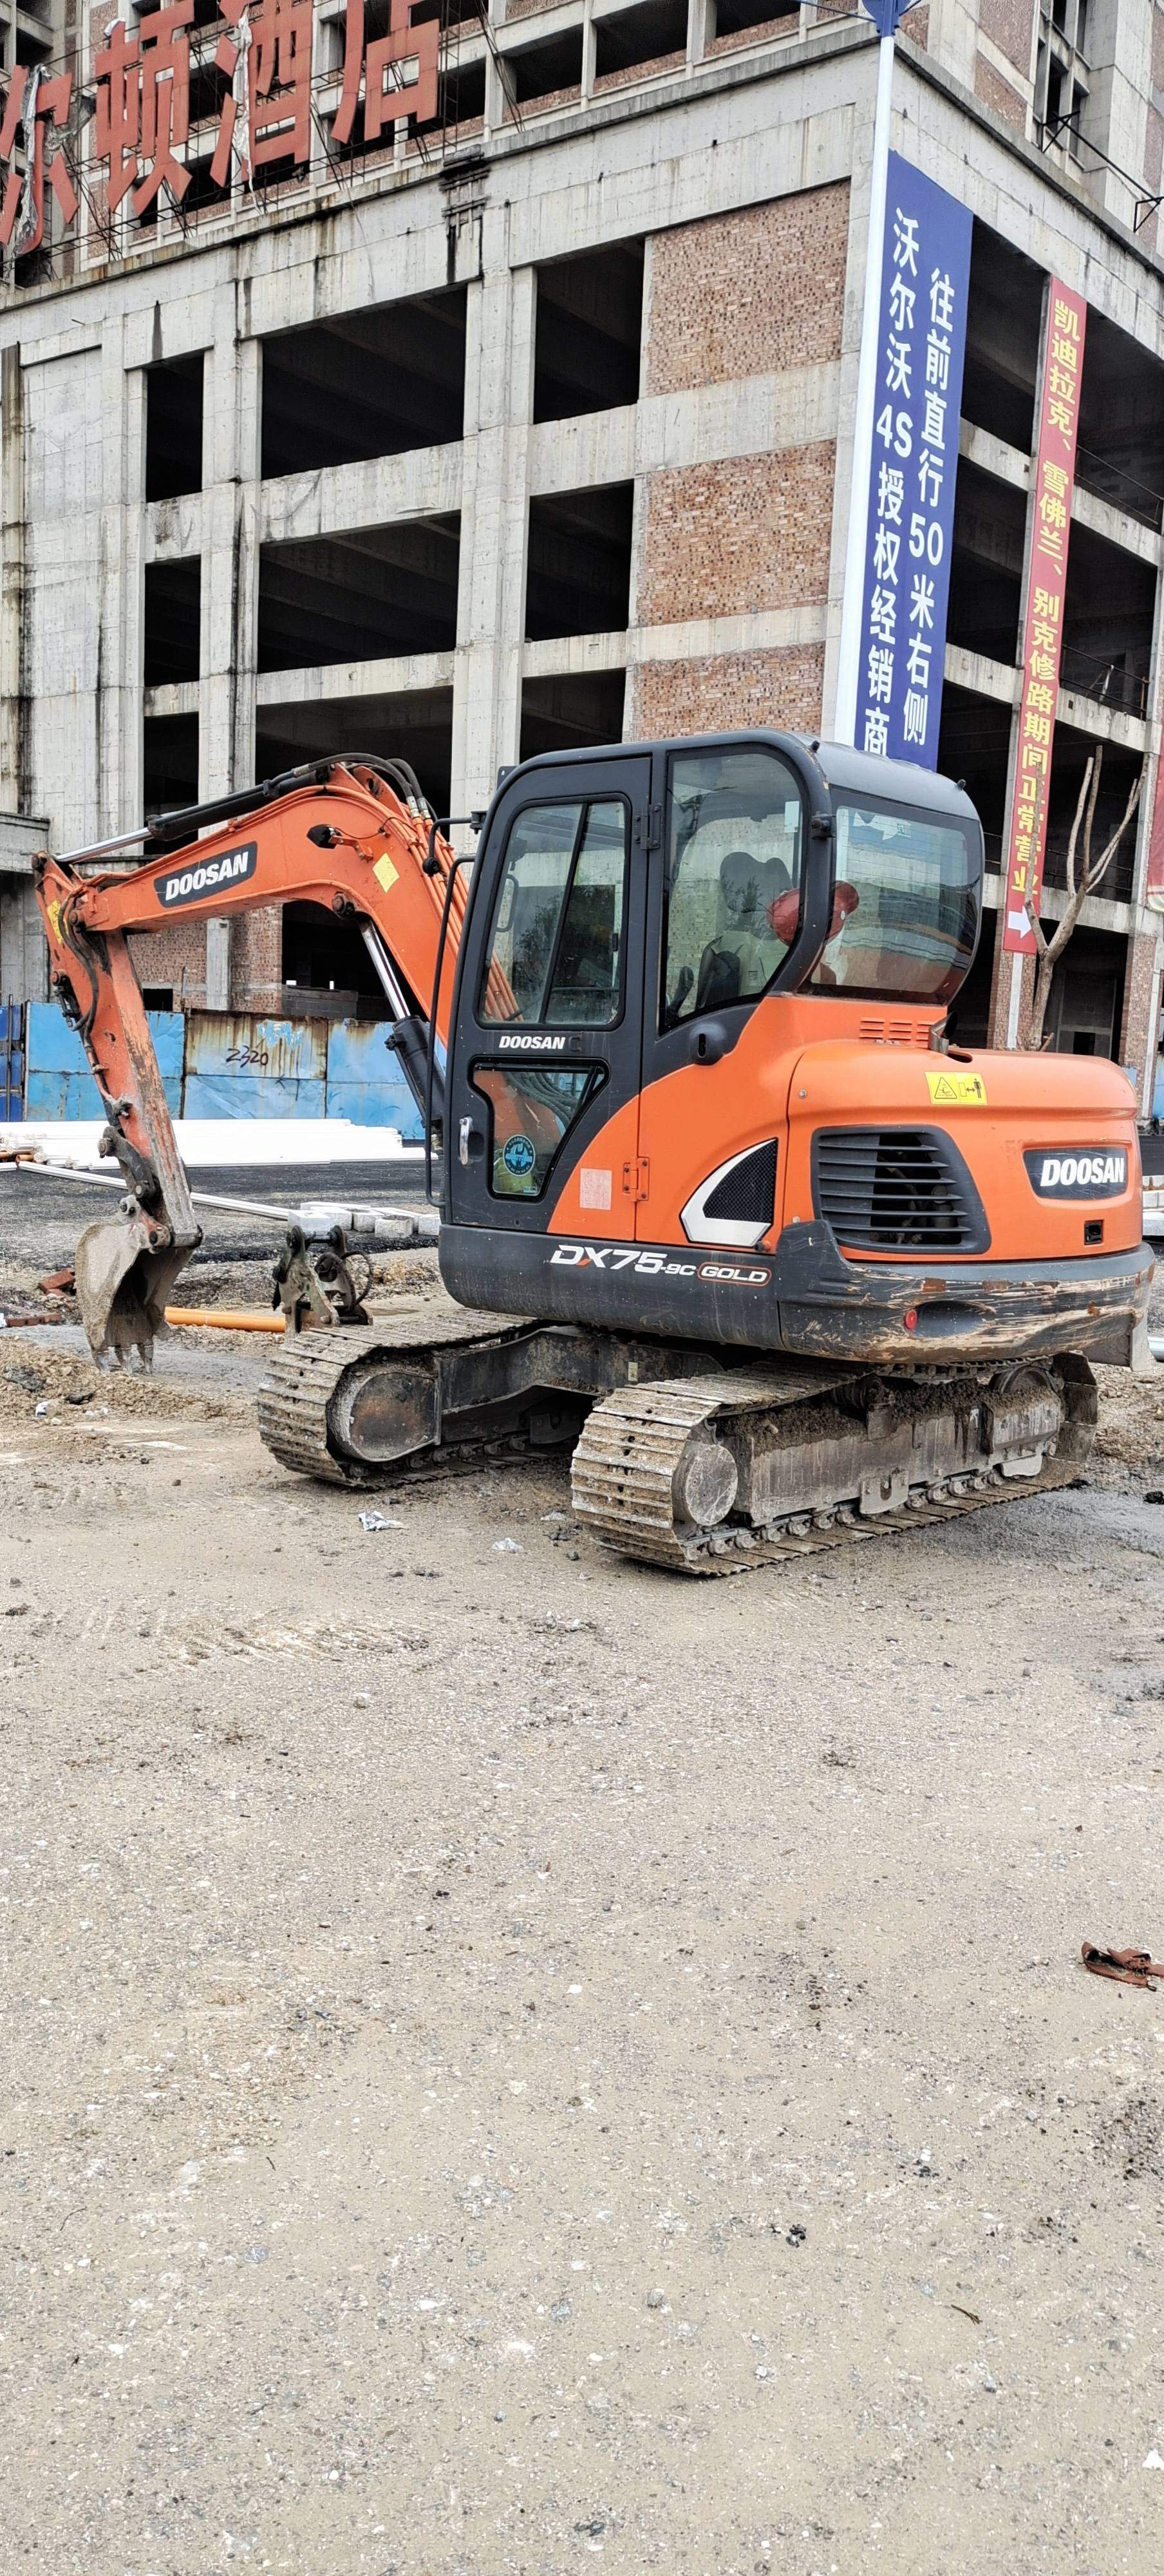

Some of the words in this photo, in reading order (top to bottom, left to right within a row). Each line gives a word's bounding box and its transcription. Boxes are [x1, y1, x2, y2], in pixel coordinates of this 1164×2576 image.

[864, 207, 919, 756] 沃尔沃4S授权经销商
[903, 267, 955, 746] 往前直行50米右侧
[165, 851, 249, 901] DOOSAN
[226, 1045, 268, 1068] 2320
[498, 1036, 566, 1050] DOOSAN
[1040, 1157, 1125, 1187] DOOSAN
[700, 1267, 767, 1283] GOLD
